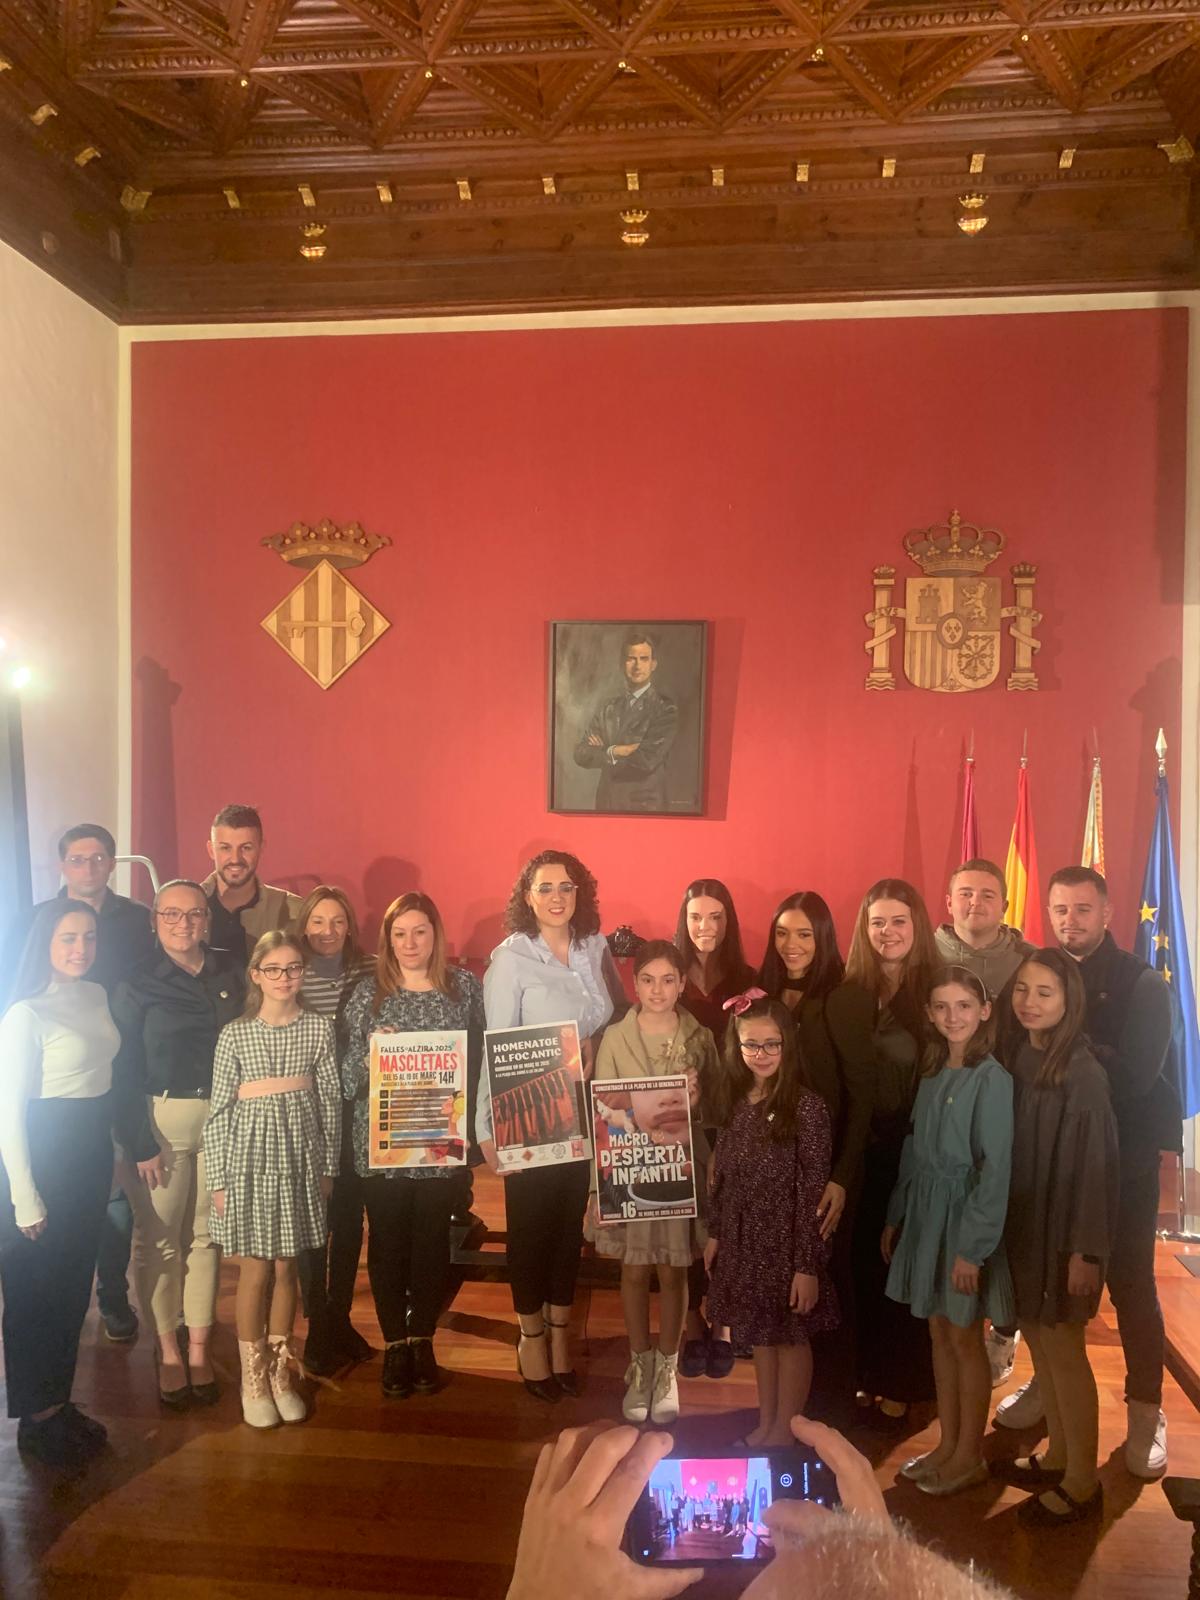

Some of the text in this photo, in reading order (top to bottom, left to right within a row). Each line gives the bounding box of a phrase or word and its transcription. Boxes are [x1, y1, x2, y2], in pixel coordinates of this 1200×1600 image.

[408, 1045, 433, 1053] ALZIRA
[494, 1047, 562, 1064] AL FOC ANTIC
[379, 1053, 458, 1073] MASCLETAES
[383, 1073, 392, 1081] DEL
[413, 1072, 418, 1080] DE
[420, 1071, 437, 1080] MARÇ
[439, 1071, 455, 1084] 14H
[609, 1132, 649, 1147] MACRO
[600, 1141, 687, 1168] DESPERTÀ
[612, 1162, 688, 1186] INFANTIL
[620, 1201, 637, 1219] 16
